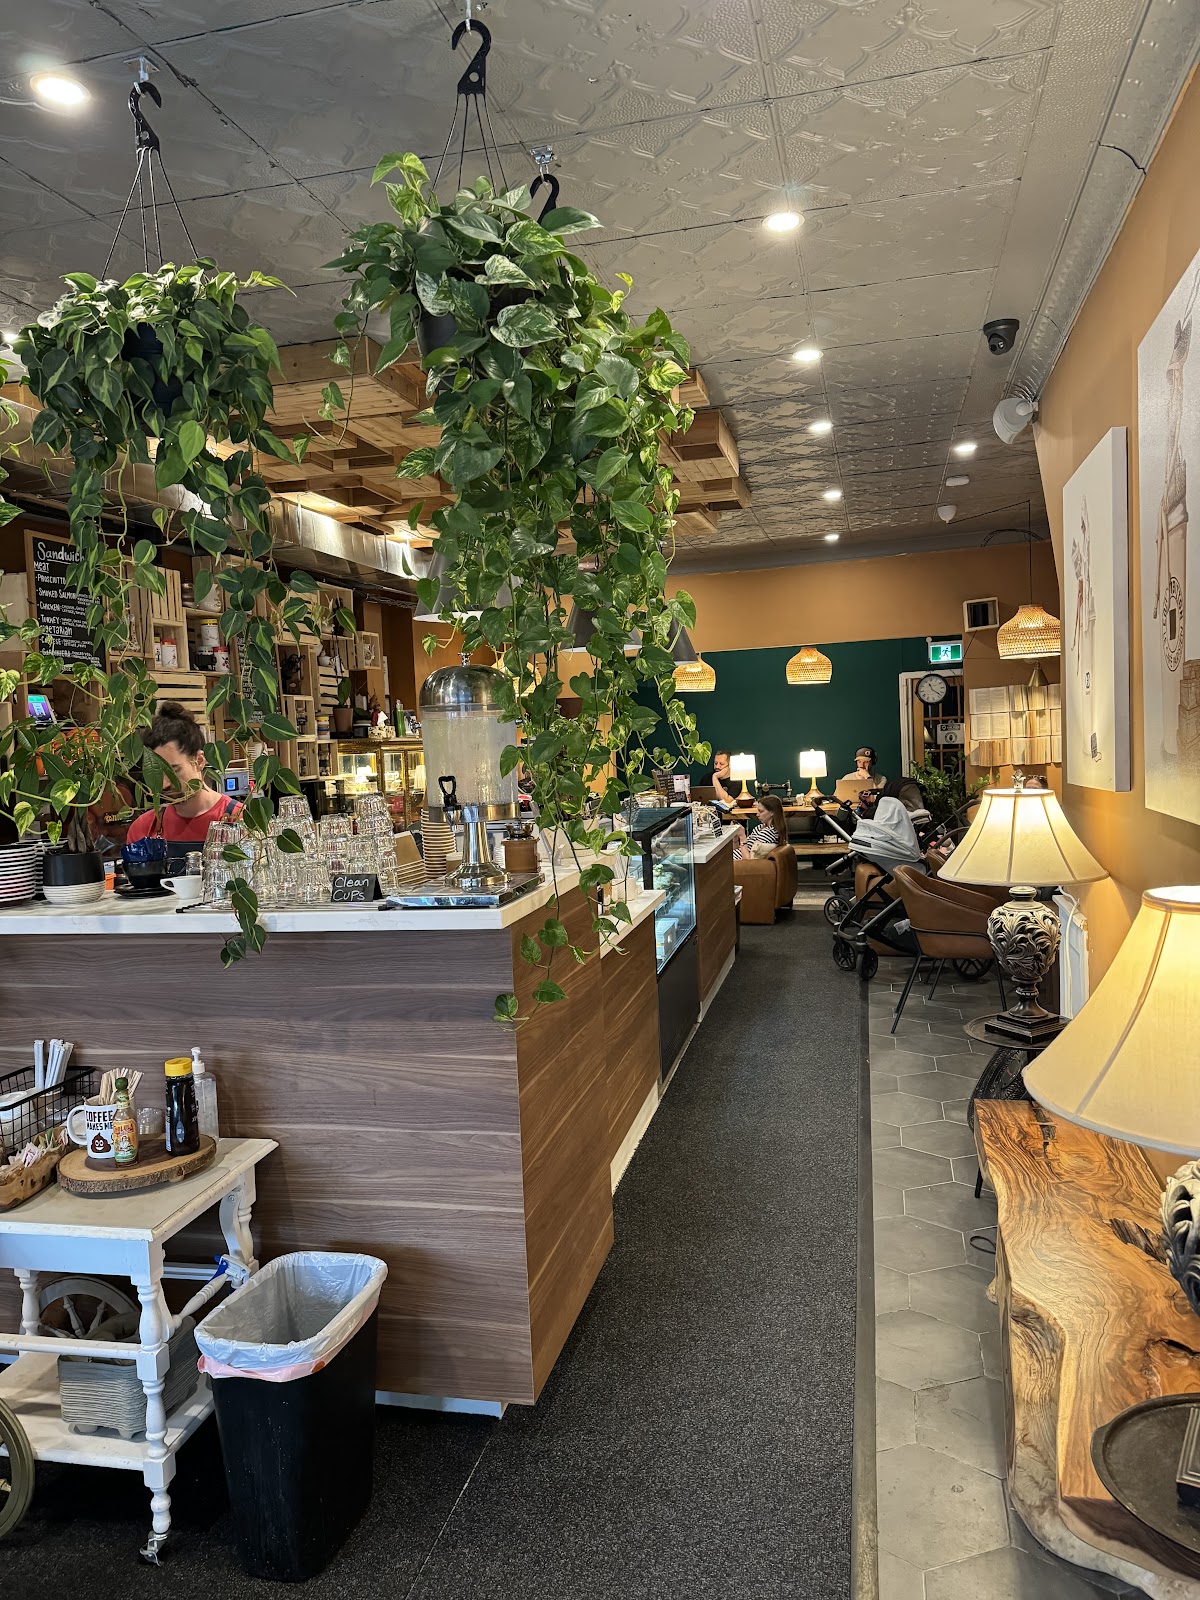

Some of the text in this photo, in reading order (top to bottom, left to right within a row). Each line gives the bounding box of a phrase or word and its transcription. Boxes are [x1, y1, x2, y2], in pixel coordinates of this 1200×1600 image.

[335, 876, 369, 887] Clean
[85, 1110, 113, 1122] COFFEE
[86, 1122, 104, 1131] MAKES
